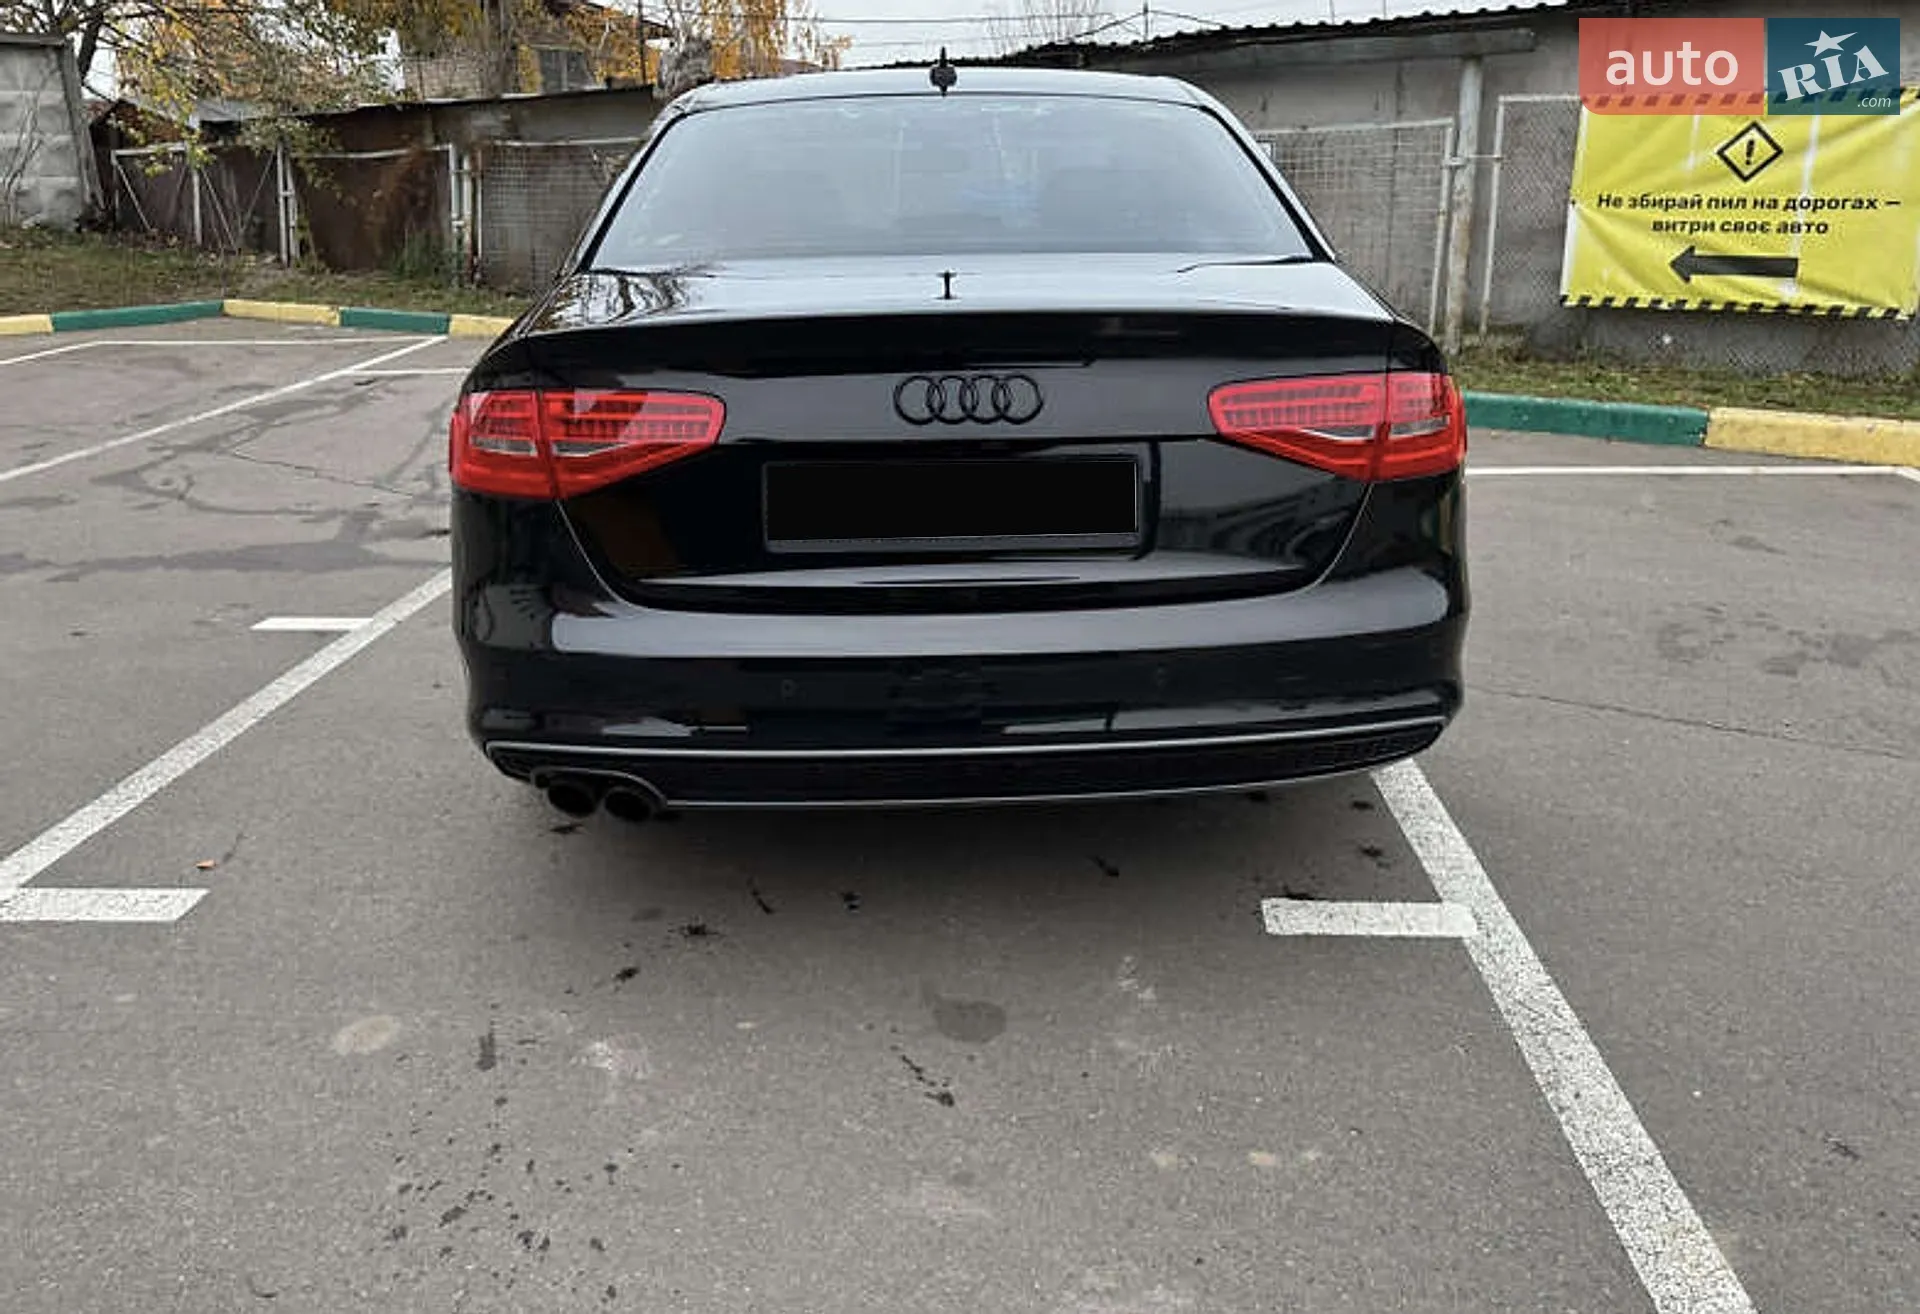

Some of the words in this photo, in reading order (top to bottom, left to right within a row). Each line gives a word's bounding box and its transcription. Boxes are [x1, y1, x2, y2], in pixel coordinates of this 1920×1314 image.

[1597, 193, 1623, 209] Не
[1628, 193, 1702, 212] збирай
[1706, 196, 1746, 210] пил
[1752, 197, 1778, 210] на
[1783, 197, 1878, 213] дорогах
[1652, 220, 1716, 235] витри
[1720, 220, 1771, 234] своє
[1776, 221, 1829, 235] авто
